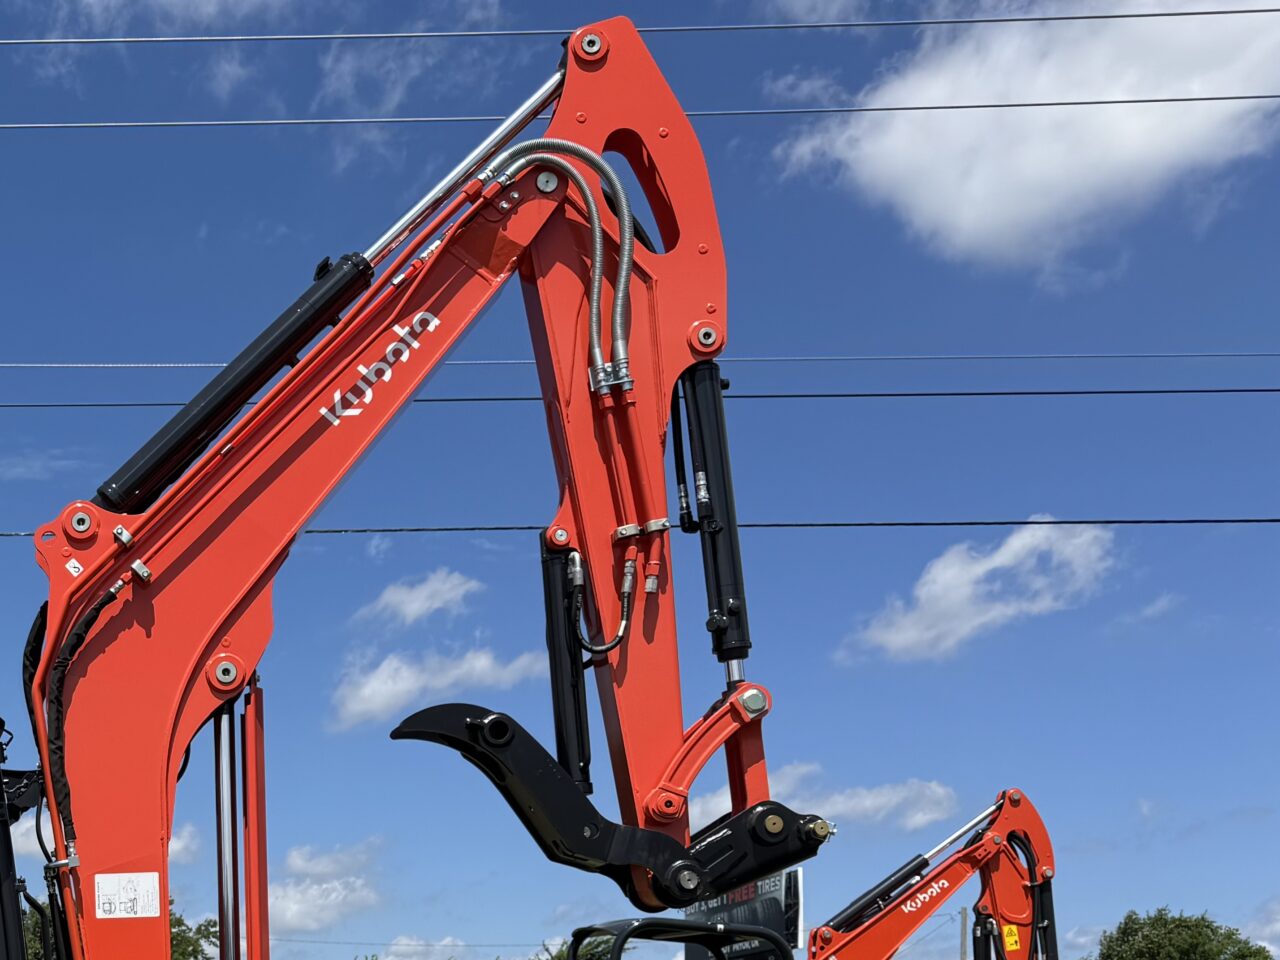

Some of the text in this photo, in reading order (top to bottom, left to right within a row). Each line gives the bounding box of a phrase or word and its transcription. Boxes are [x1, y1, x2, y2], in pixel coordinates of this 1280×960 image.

[319, 312, 441, 426] Kubota
[728, 881, 756, 904] FREE
[757, 876, 781, 895] TIRES
[901, 879, 950, 913] Kubota
